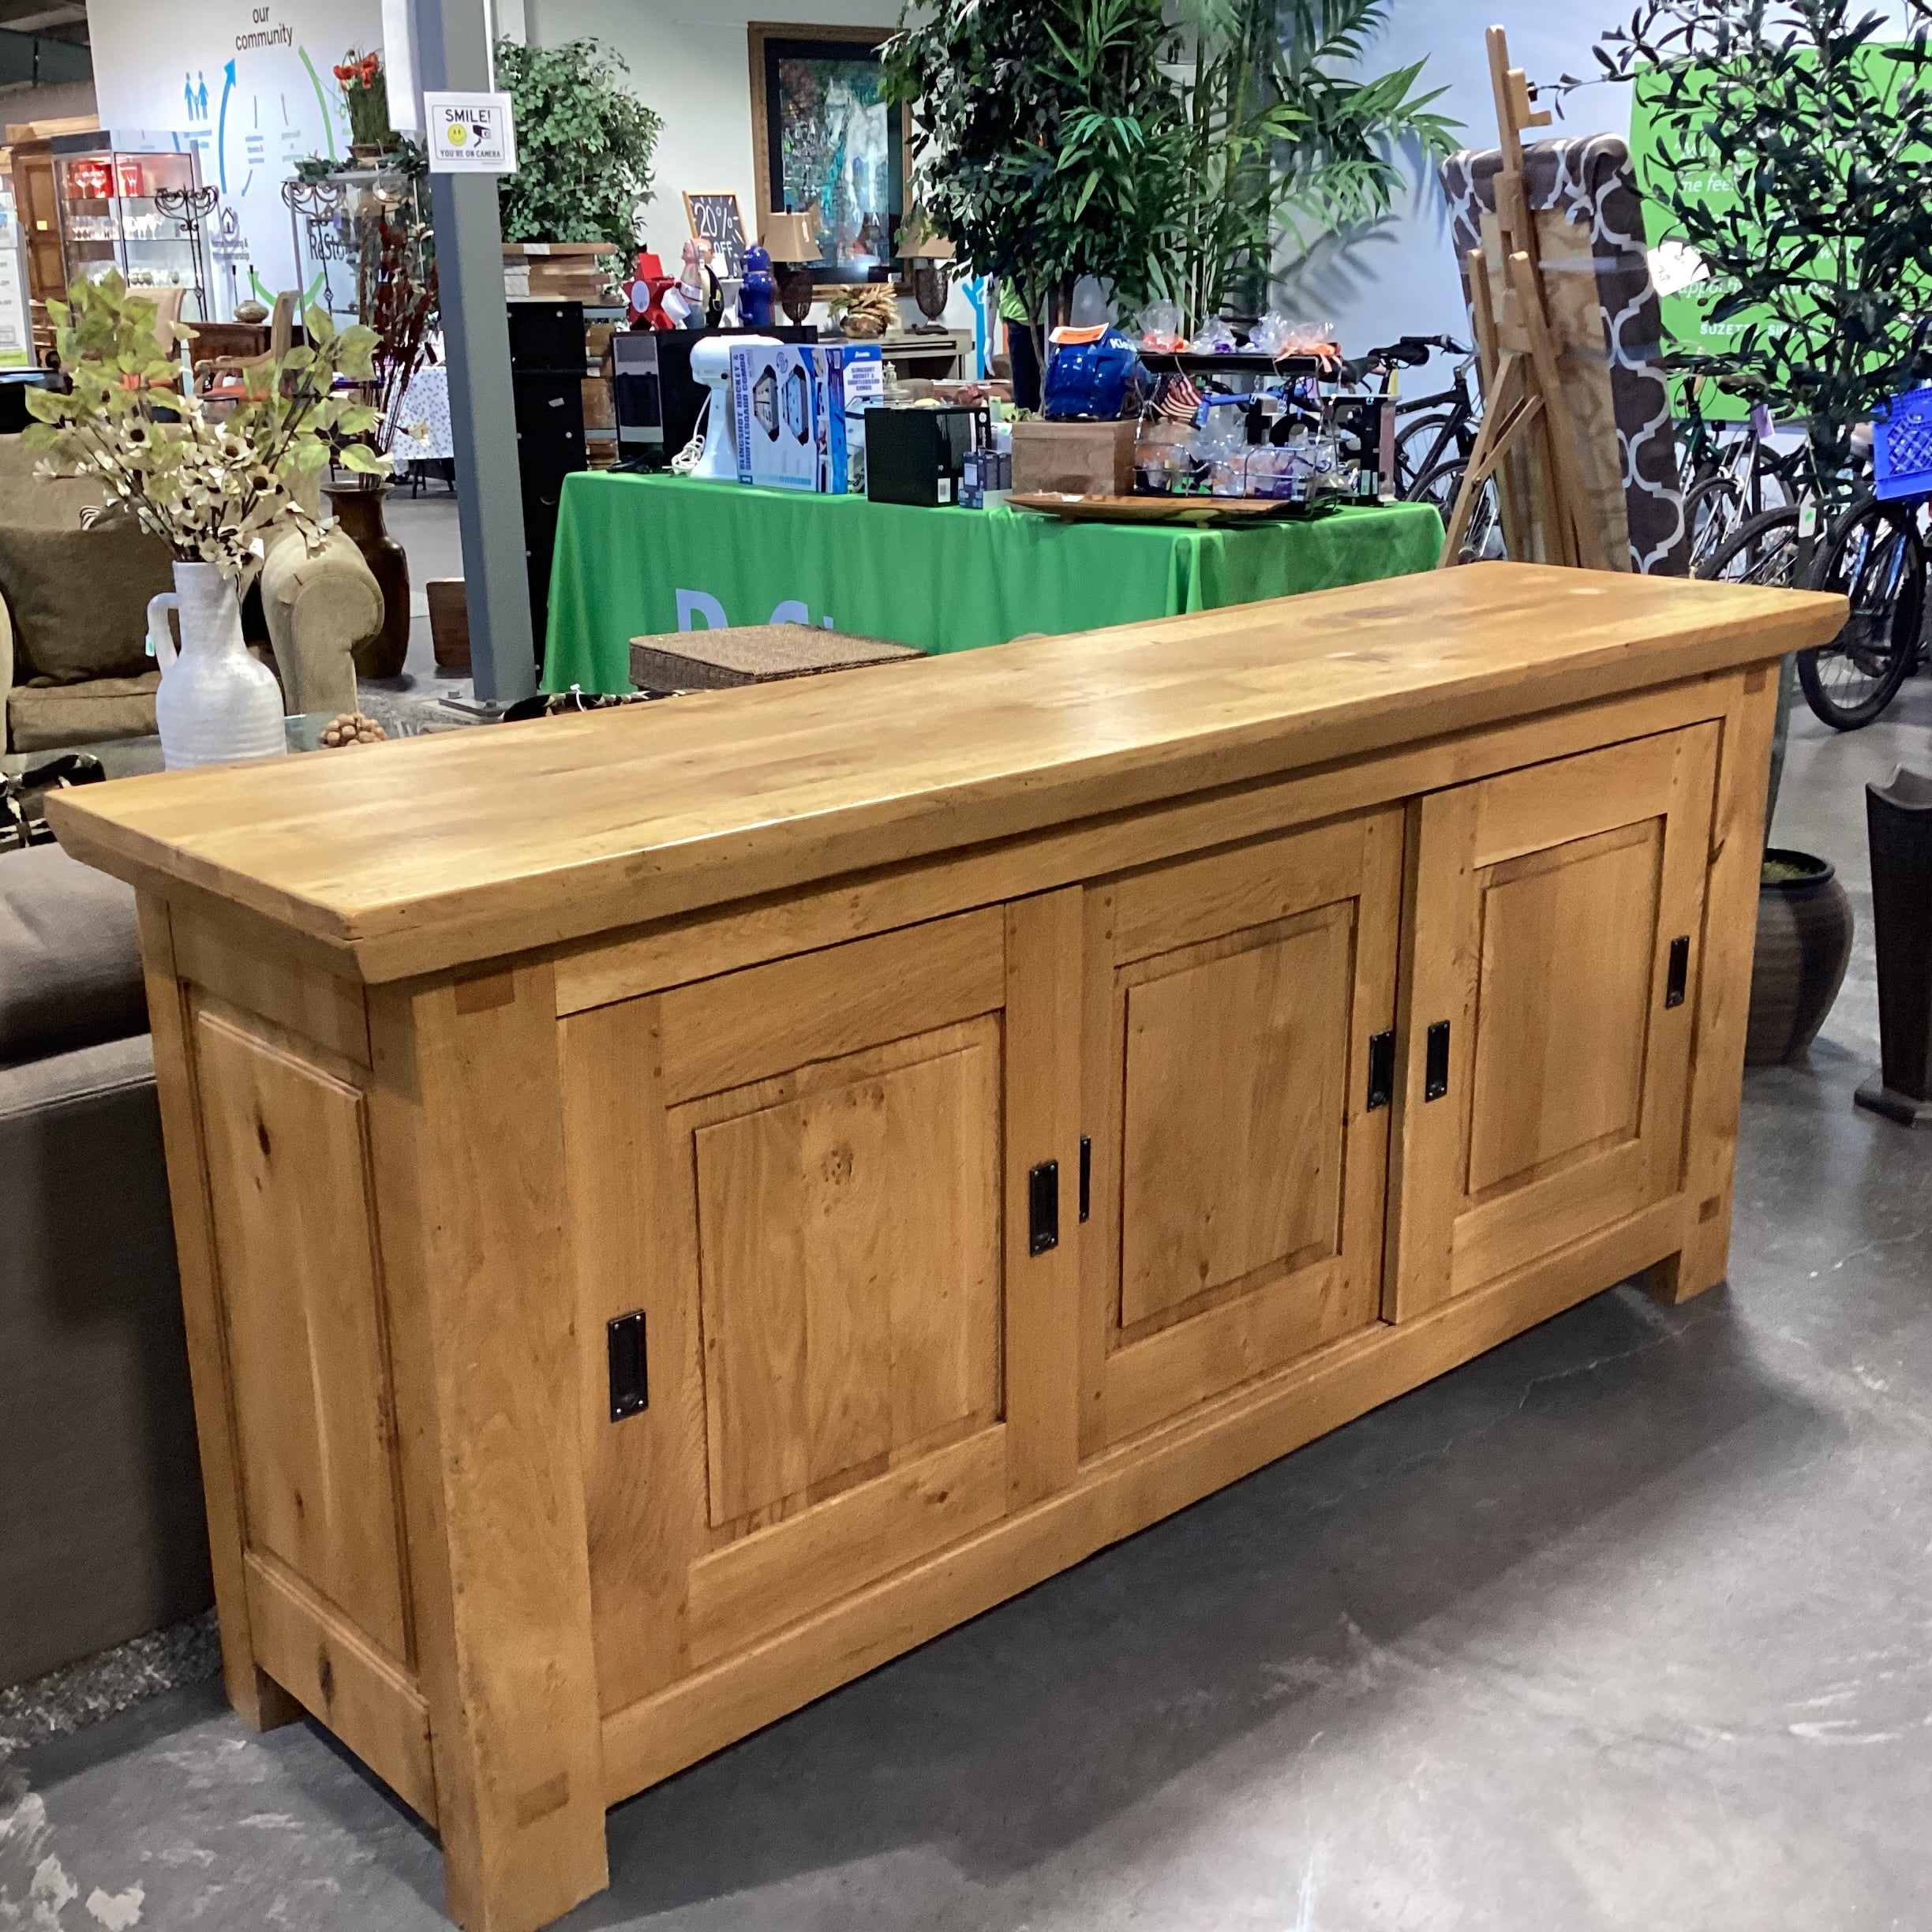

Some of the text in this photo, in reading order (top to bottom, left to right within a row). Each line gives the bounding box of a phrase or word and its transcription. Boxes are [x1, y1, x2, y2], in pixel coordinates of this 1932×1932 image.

[253, 6, 269, 24] our
[235, 23, 293, 51] community
[445, 109, 491, 123] SMILE!
[440, 149, 464, 158] YOU'RE
[476, 150, 501, 159] CAMERA
[695, 202, 734, 239] 20%
[713, 241, 732, 258] OFF
[739, 354, 748, 391] COMBO
[734, 365, 743, 408] HOCKEY
